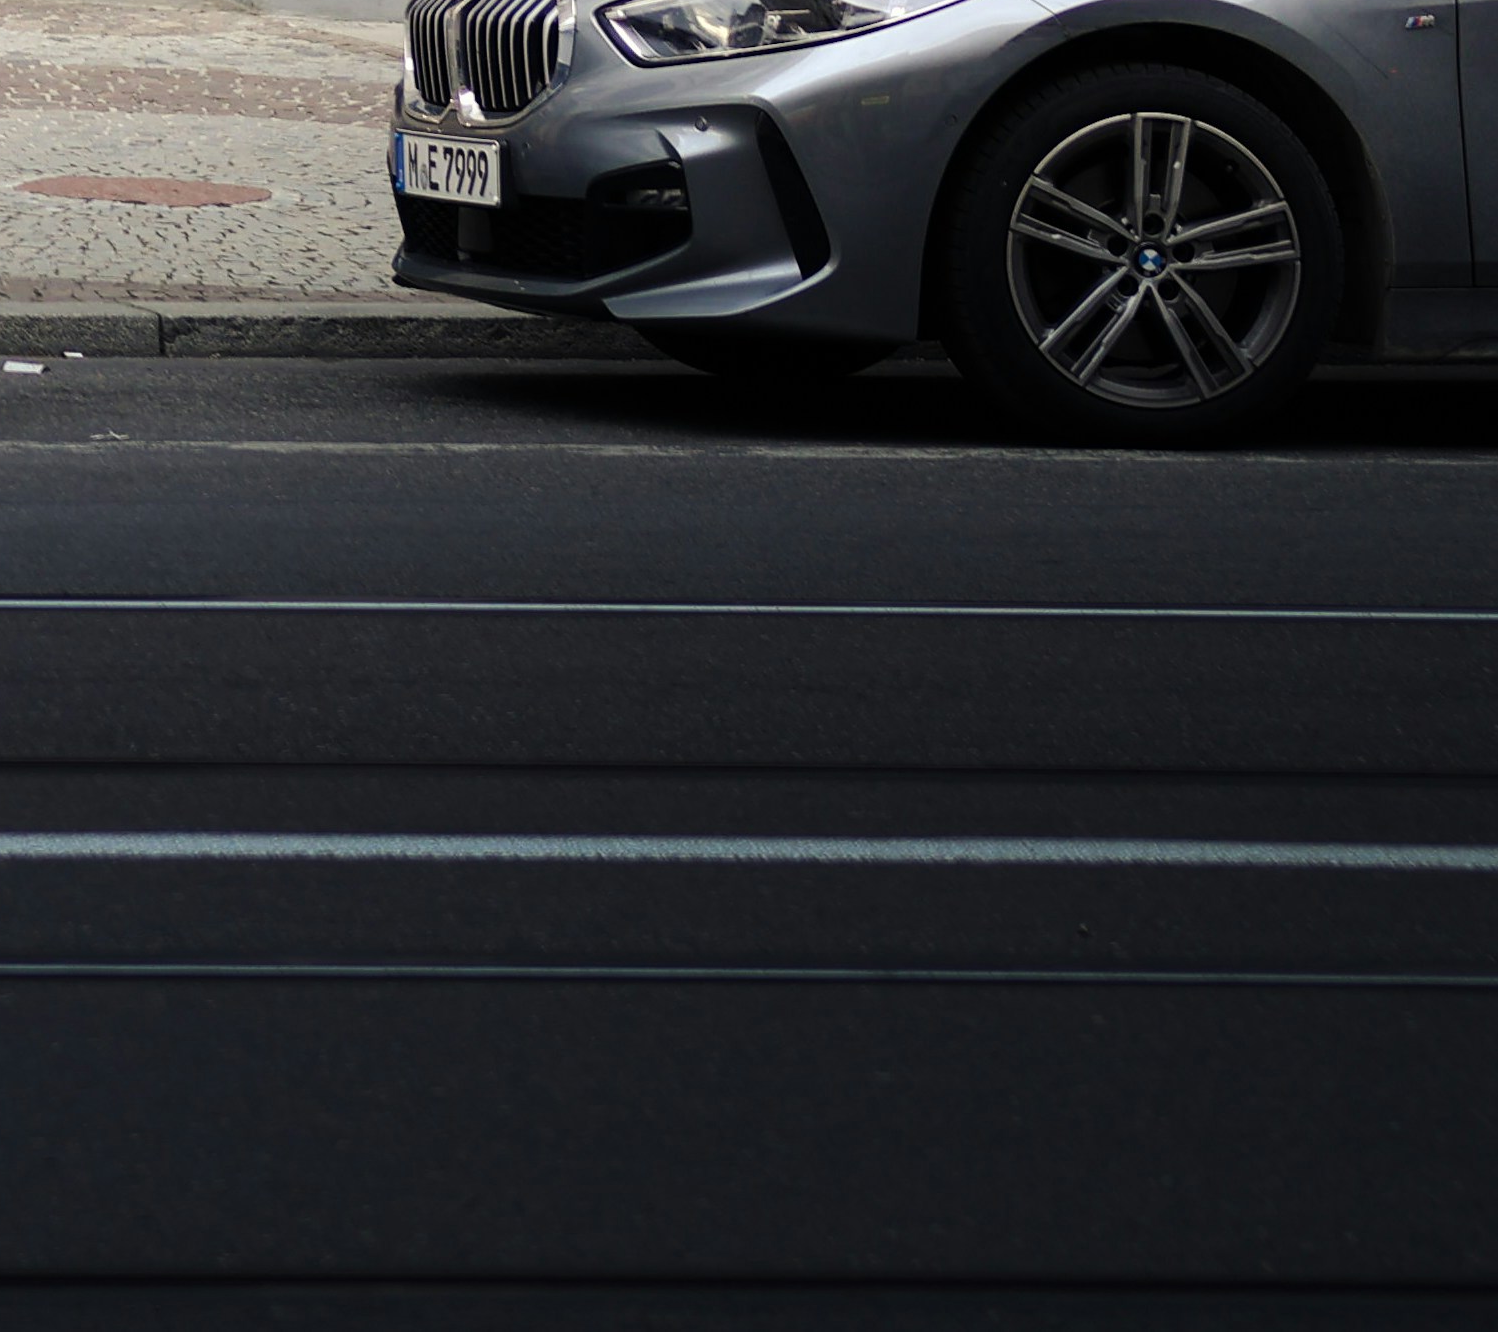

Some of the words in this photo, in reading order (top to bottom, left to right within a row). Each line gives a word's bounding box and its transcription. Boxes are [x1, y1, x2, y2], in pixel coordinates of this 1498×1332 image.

[408, 142, 419, 189] M
[428, 144, 439, 191] E
[443, 147, 489, 197] 7999
